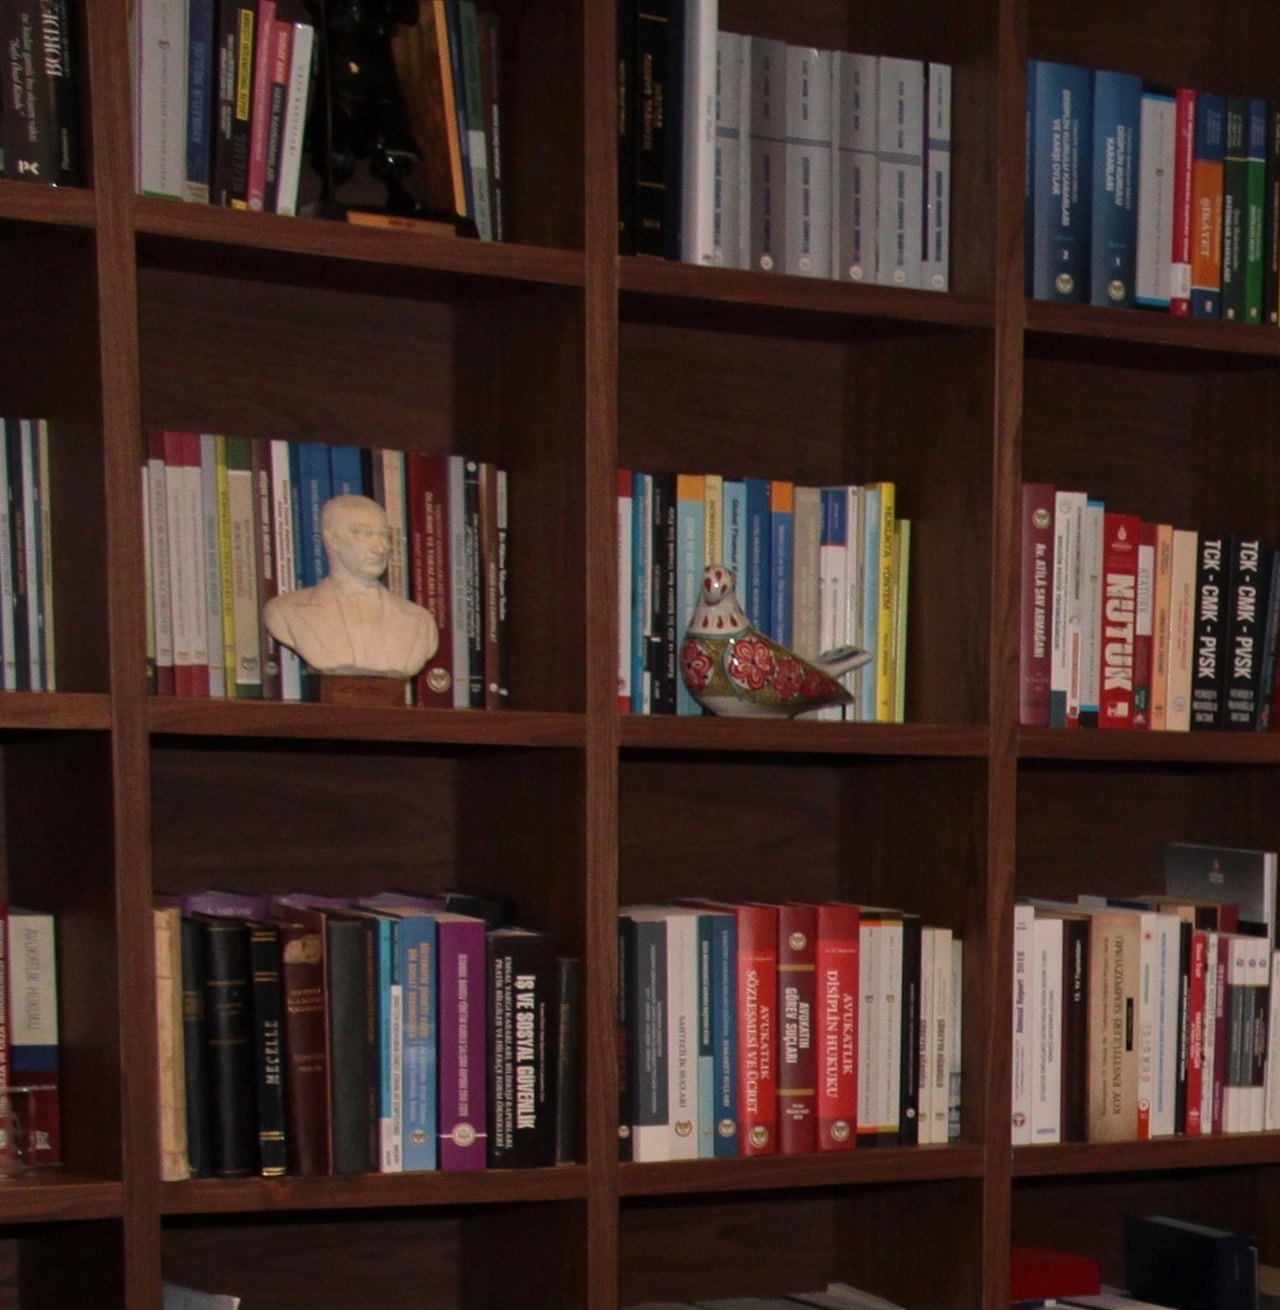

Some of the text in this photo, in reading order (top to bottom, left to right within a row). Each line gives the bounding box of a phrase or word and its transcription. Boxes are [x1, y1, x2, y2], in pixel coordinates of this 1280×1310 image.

[1202, 539, 1223, 571] TCK
[1238, 540, 1259, 572] TCK
[1104, 573, 1136, 692] NUTUK
[1199, 584, 1220, 623] CMK
[1236, 585, 1257, 623] CMK
[1197, 635, 1218, 680] PVSK
[1233, 635, 1254, 680] PVSK
[263, 1019, 281, 1085] MECELLE
[514, 974, 538, 1130] İŞ VE SOSYAL GÜVENLİK
[743, 970, 761, 1115] SÖZLEŞMESİ VE ÜCRET
[759, 1004, 770, 1081] AVUKATLIK
[781, 986, 801, 1064] GÖREV SUÇLARI
[825, 969, 841, 1099] DİSİPLİN HUKUKU
[842, 992, 854, 1075] AVUKATLIK
[1111, 935, 1125, 1115] KÖY ENSTİTÜLERİ SEMPOZYUMU
